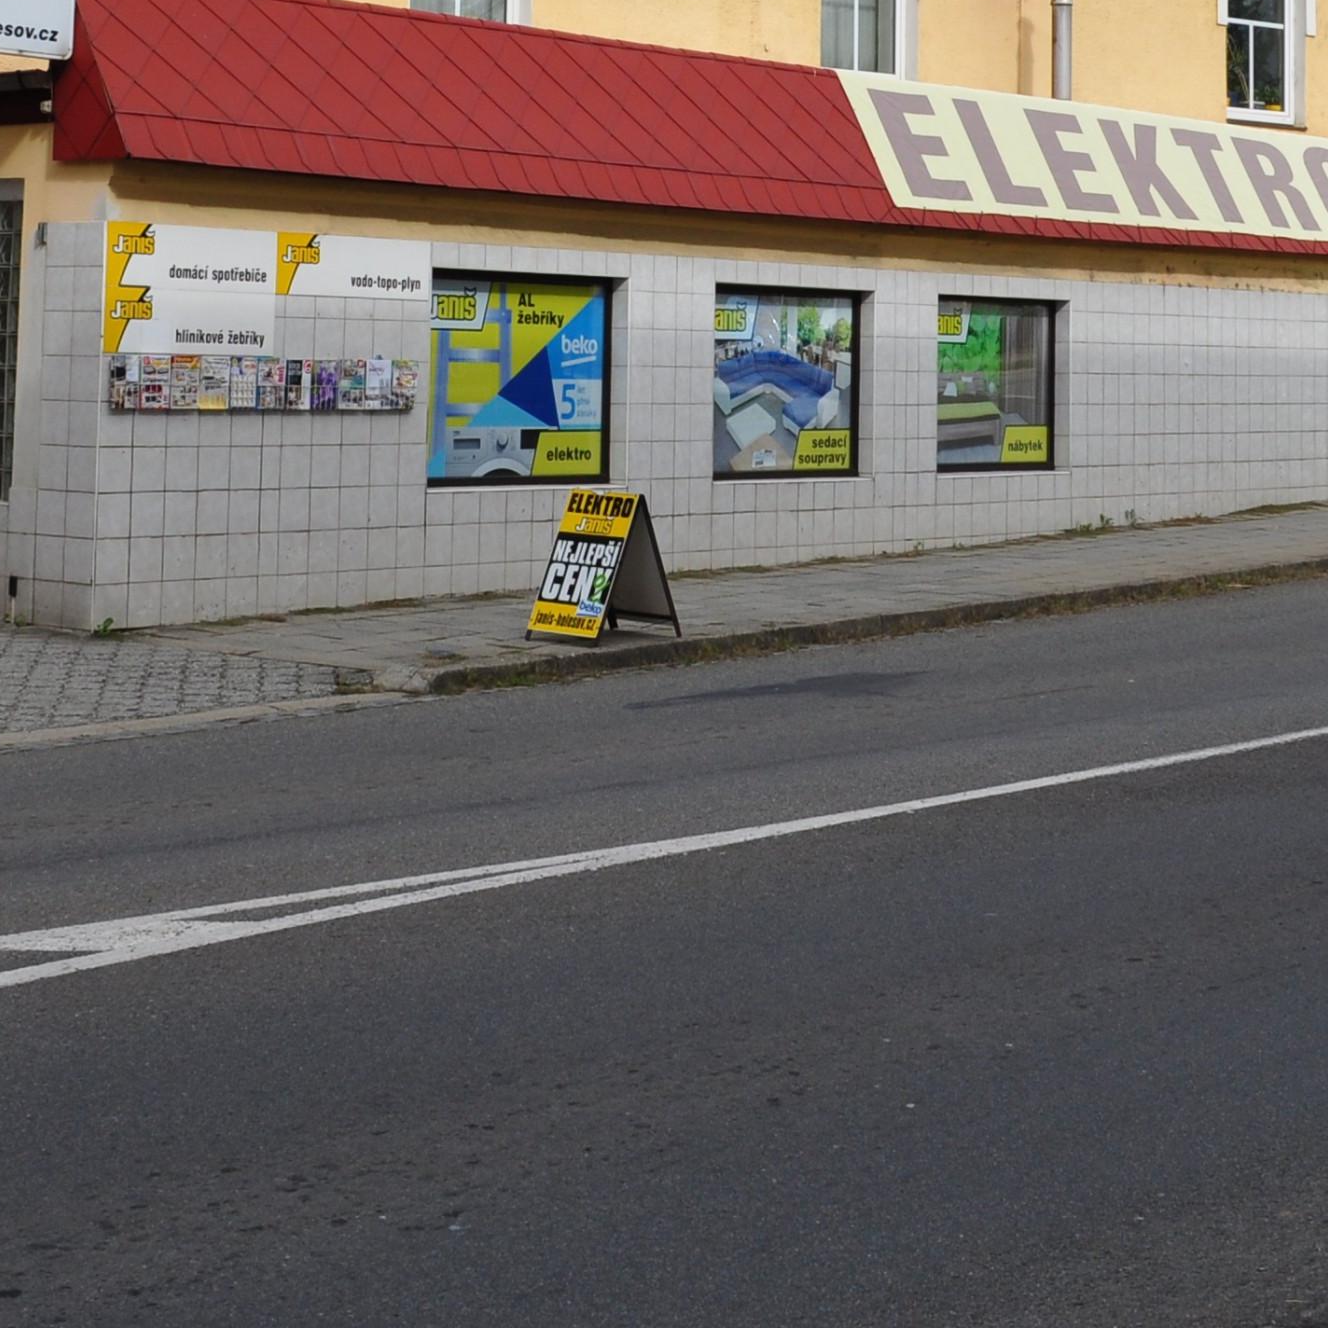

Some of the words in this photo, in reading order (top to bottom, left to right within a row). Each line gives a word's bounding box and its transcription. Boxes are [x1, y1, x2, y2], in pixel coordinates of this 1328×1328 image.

[113, 230, 155, 255] Janiš
[282, 240, 321, 264] Janiš
[169, 264, 209, 281] domácí
[211, 265, 267, 284] spotřebiče
[350, 274, 421, 292] vodo-topo-plyn
[110, 295, 153, 320] Janiš
[518, 292, 535, 308] AL
[517, 311, 565, 329] žebříky
[715, 301, 748, 332] aniš
[938, 307, 963, 336] aniš
[175, 328, 224, 345] hliníkové
[227, 330, 265, 349] žebříky
[561, 334, 598, 354] beko
[561, 383, 577, 420] 5
[811, 434, 848, 450] sedací
[1007, 438, 1044, 454] nábytek
[546, 447, 592, 462] elektro
[798, 451, 848, 468] soupravy
[567, 493, 635, 518] ELEKTRO
[552, 539, 622, 567] NEJLEPŠÍ
[541, 562, 615, 604] CENY
